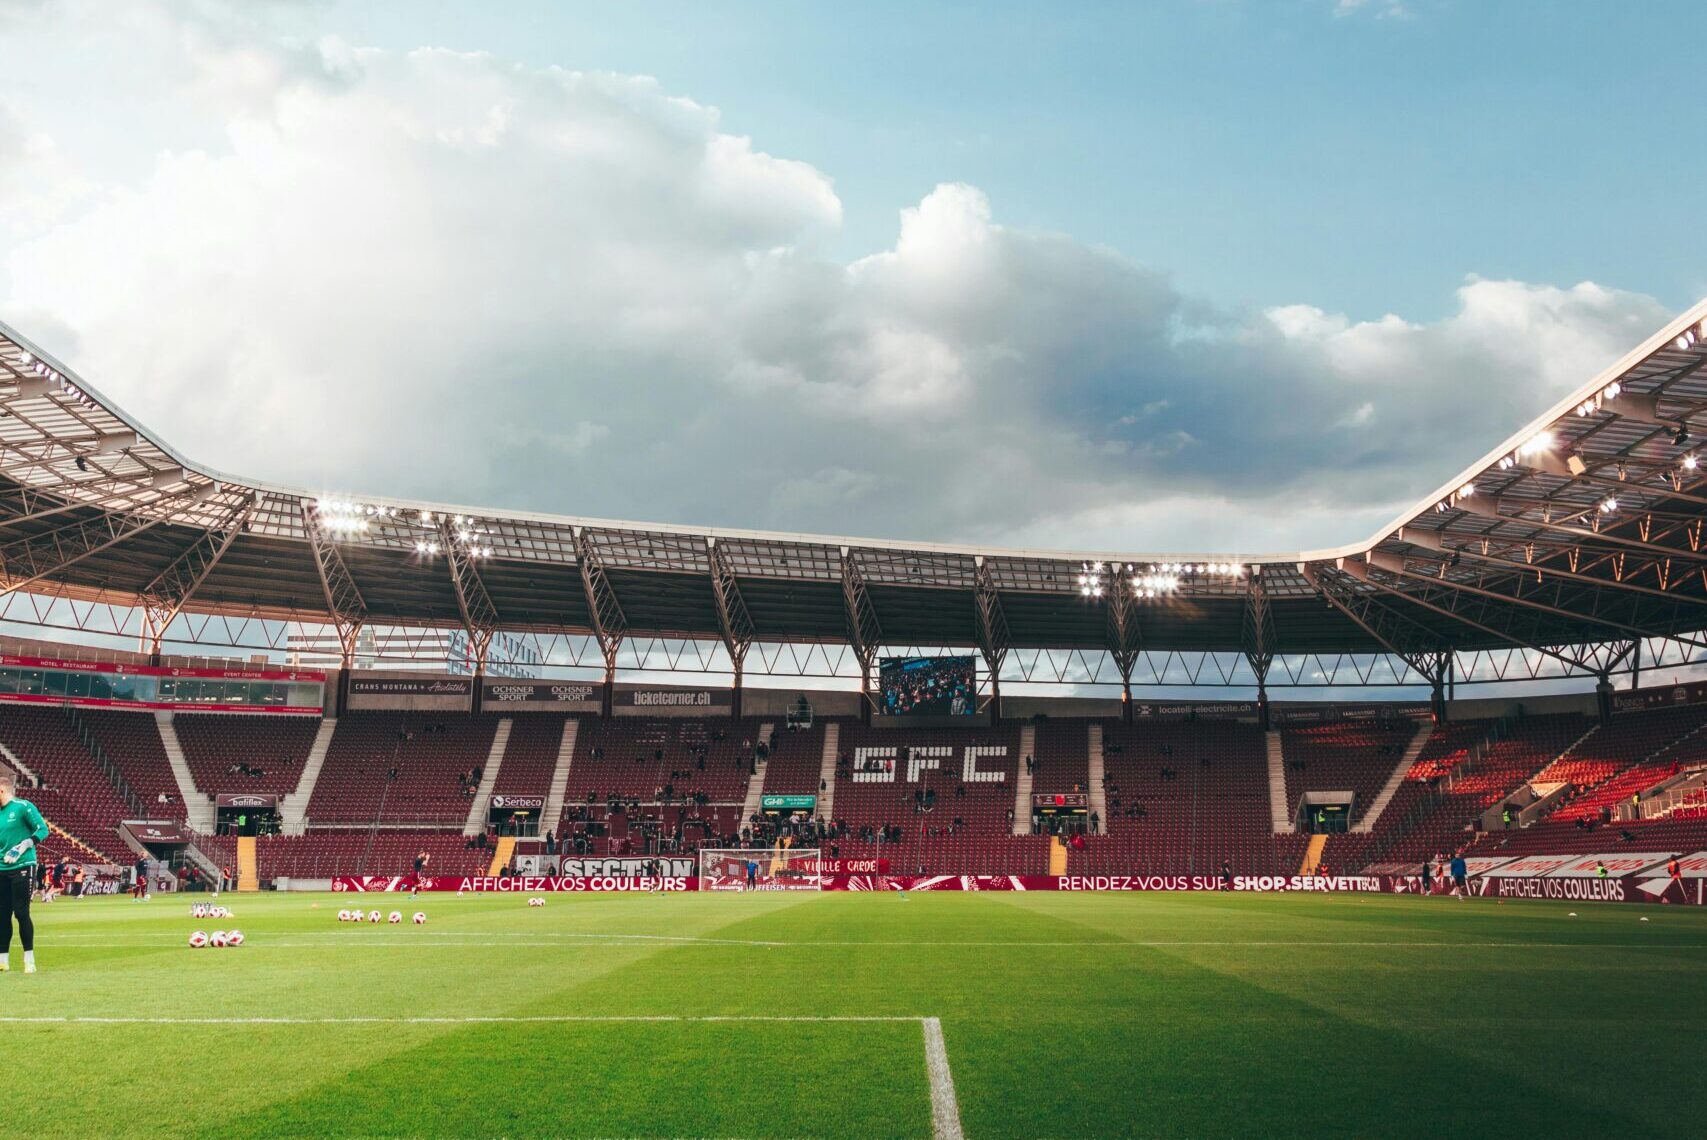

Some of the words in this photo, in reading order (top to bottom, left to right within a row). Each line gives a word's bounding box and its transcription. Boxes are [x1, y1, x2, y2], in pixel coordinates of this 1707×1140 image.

[634, 691, 711, 706] ticketcorner.ch
[232, 798, 263, 806] bafiflex
[504, 797, 542, 806] Serbeco
[460, 877, 545, 891] AFFICHEZ
[550, 877, 586, 891] VOS
[590, 877, 687, 891] COULEURS
[1058, 876, 1188, 890] RENDEZ-VOUS
[1499, 878, 1542, 898] AFFICHEZ
[1542, 878, 1562, 898] VOS
[1564, 878, 1625, 900] COULEURS
